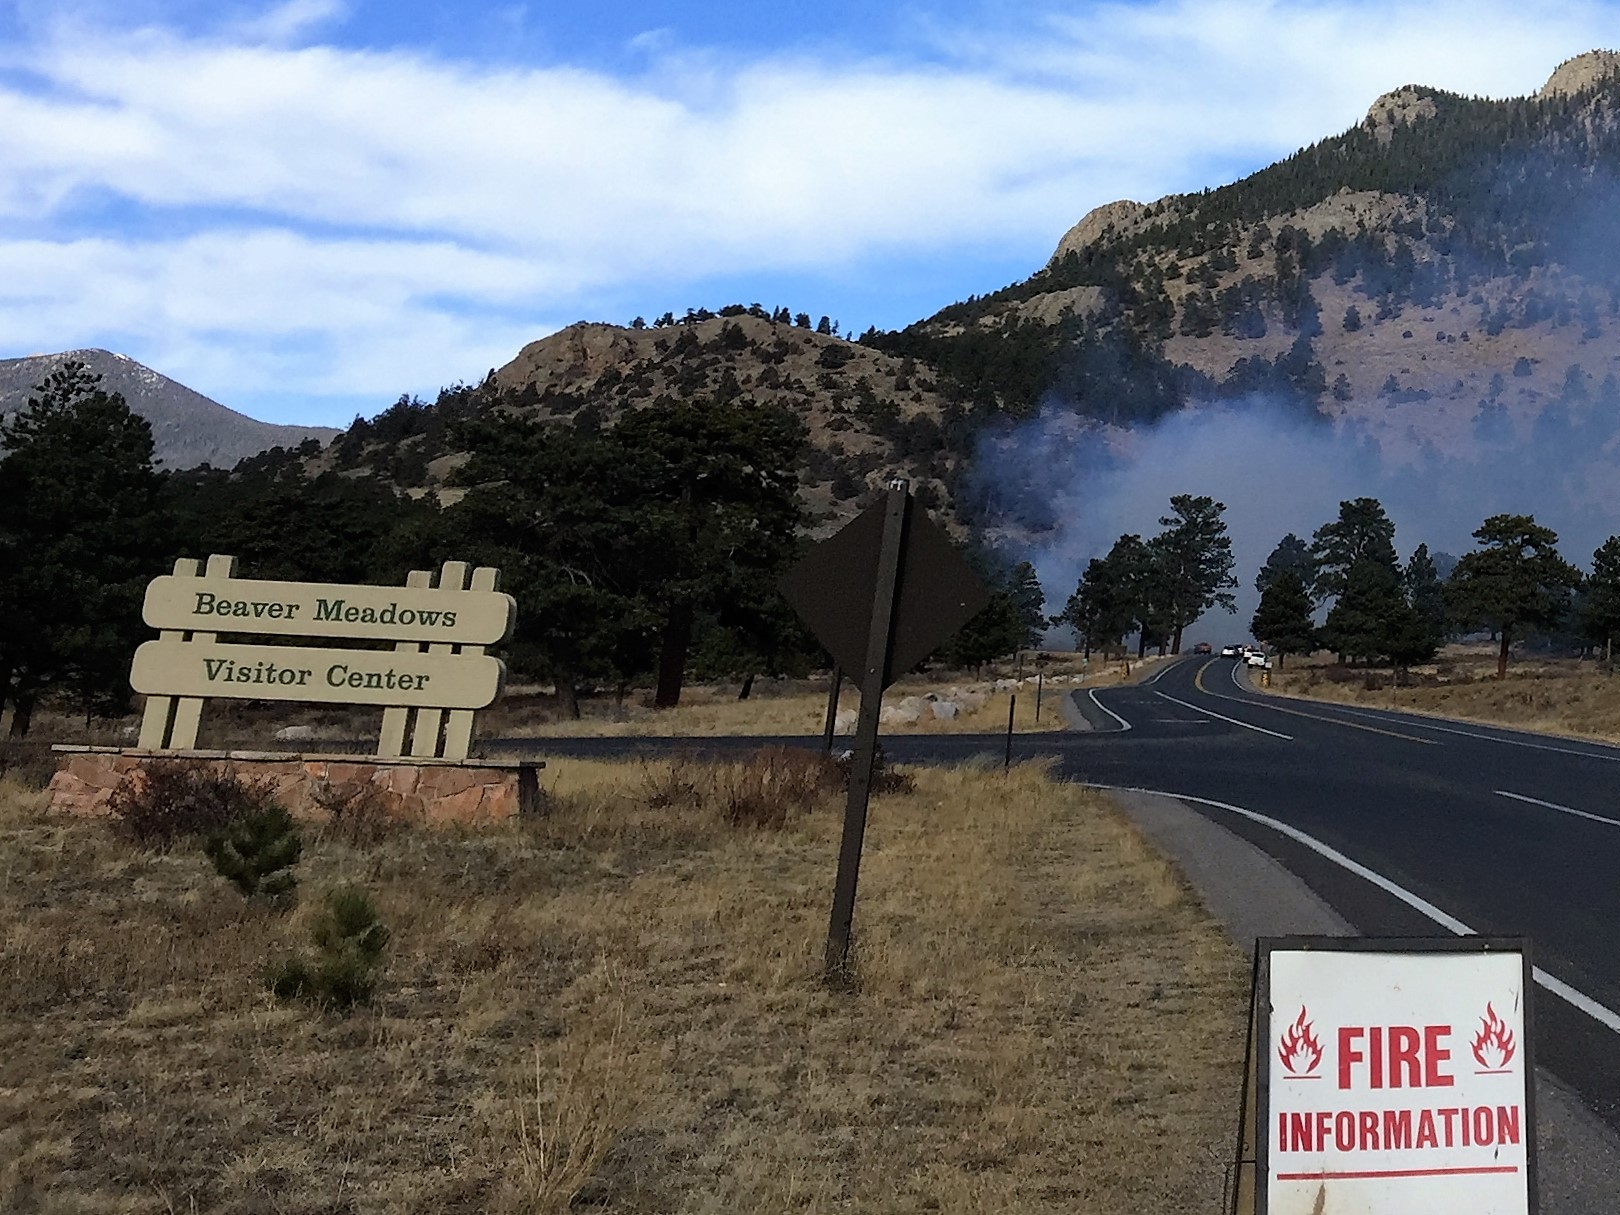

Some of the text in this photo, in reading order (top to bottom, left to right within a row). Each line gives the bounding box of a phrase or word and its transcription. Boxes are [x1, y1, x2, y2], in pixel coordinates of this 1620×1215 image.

[192, 592, 457, 627] Beaver Meadows
[203, 658, 430, 690] Visitor Center
[1338, 1025, 1454, 1090] FIRE
[1279, 1105, 1520, 1152] INFORMATION
